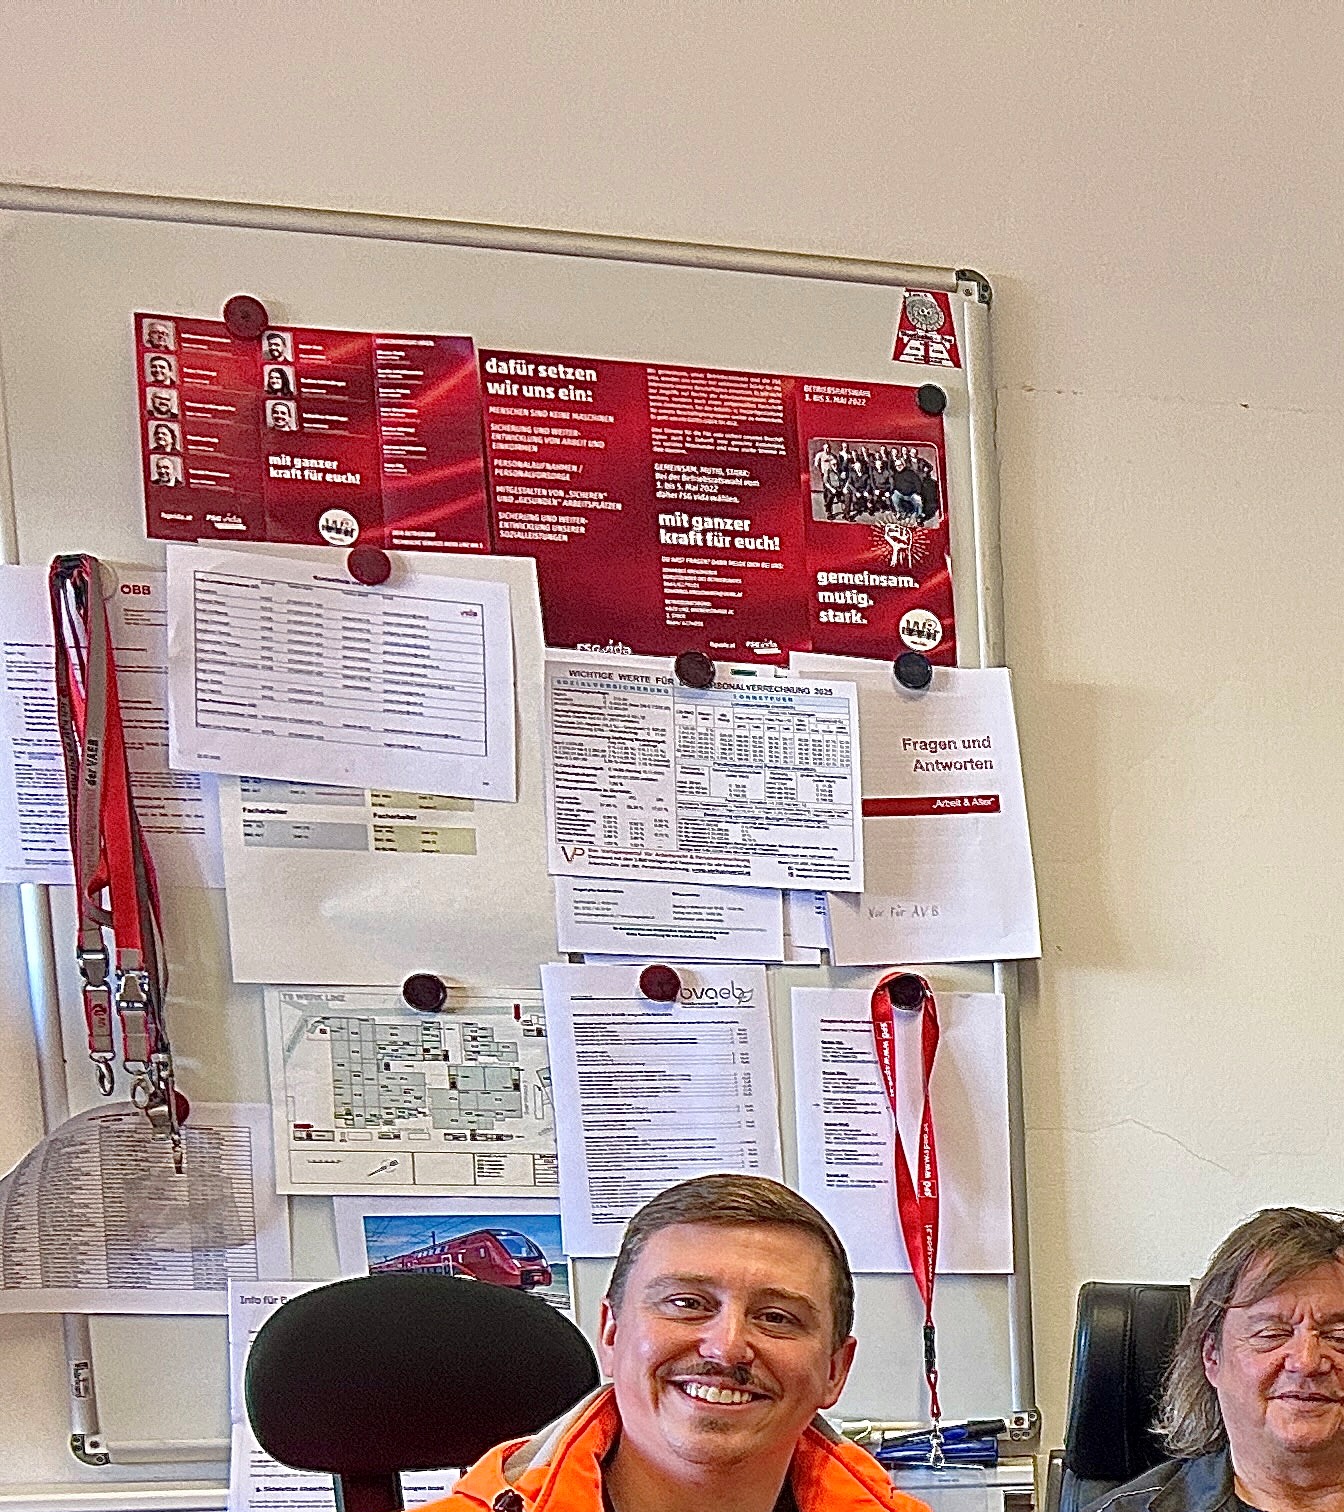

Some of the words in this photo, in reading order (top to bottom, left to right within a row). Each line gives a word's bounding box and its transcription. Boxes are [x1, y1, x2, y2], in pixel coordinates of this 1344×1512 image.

[485, 357, 535, 377] dafür
[538, 364, 598, 382] setzen
[486, 380, 520, 396] wir
[522, 383, 556, 398] uns
[558, 386, 594, 403] ein:
[848, 397, 867, 406] 2022
[268, 454, 290, 466] mit
[293, 456, 339, 472] ganzer
[269, 466, 299, 481] kraft
[300, 467, 325, 482] für
[325, 470, 361, 485] euch!
[685, 483, 699, 491] Mai
[700, 484, 719, 493] 2022
[658, 512, 690, 528] mit
[691, 515, 751, 533] ganzer
[659, 528, 704, 546] kraft
[705, 532, 732, 548] für
[734, 534, 781, 551] euch!
[816, 571, 920, 589] gemeinsam.
[818, 589, 874, 608] mutig.
[819, 608, 868, 625] stark.
[568, 669, 614, 681] WICHTIGE
[618, 672, 650, 684] WERTE
[655, 674, 675, 685] FÜR
[708, 681, 811, 695] RSONALVERRECHNUNG
[901, 737, 957, 754] Fragen
[961, 735, 992, 750] und
[913, 758, 994, 772] Antworten
[963, 798, 971, 807] &
[239, 1295, 261, 1305] Info
[263, 1295, 278, 1304] für
